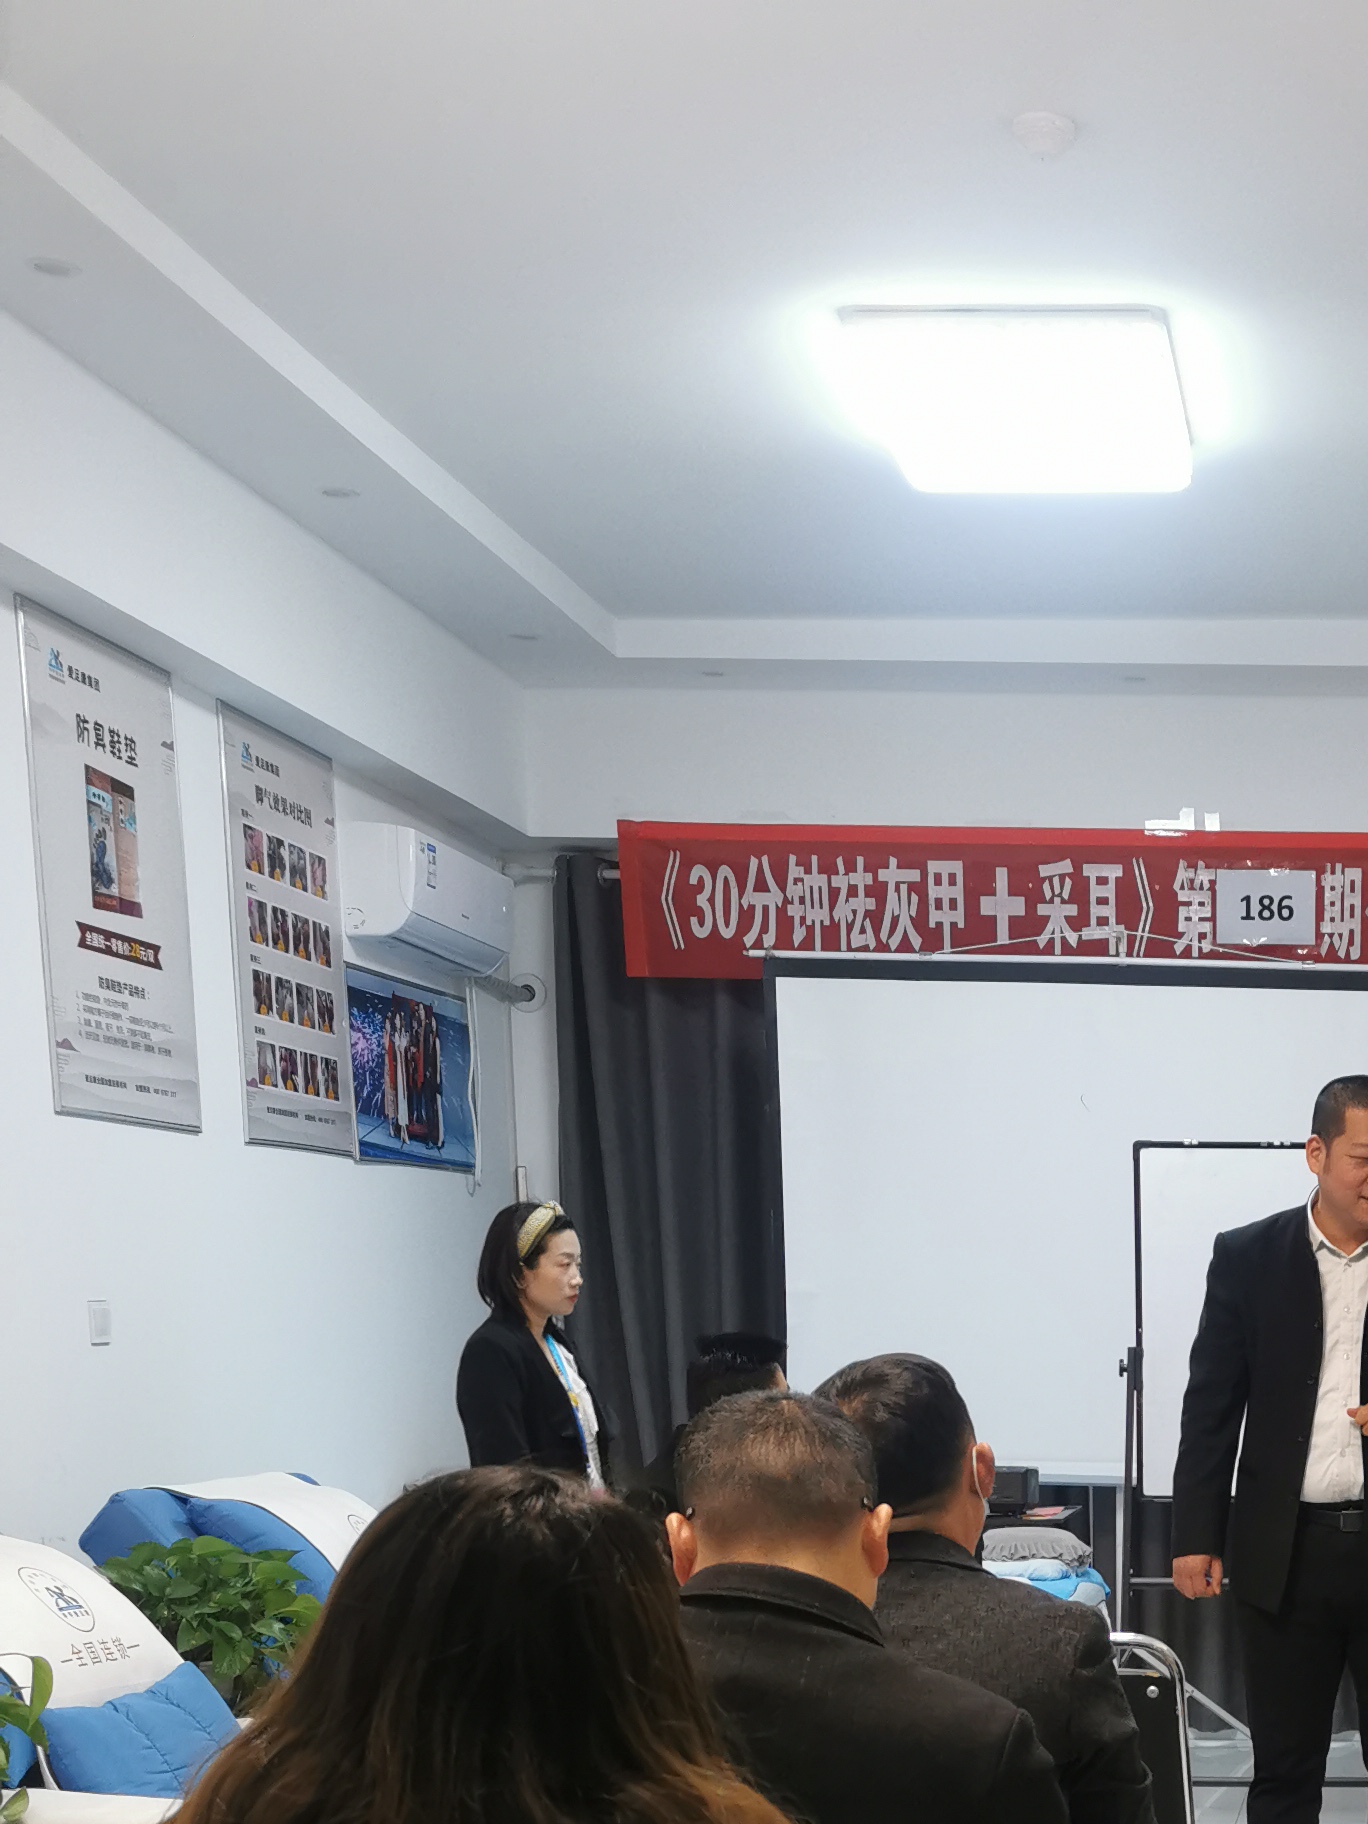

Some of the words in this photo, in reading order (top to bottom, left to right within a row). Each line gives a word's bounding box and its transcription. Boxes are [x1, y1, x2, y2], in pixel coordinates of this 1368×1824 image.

[75, 712, 139, 768] 防臭鞋垫
[254, 784, 313, 829] 脚气效果对比图
[1239, 894, 1294, 922] 186
